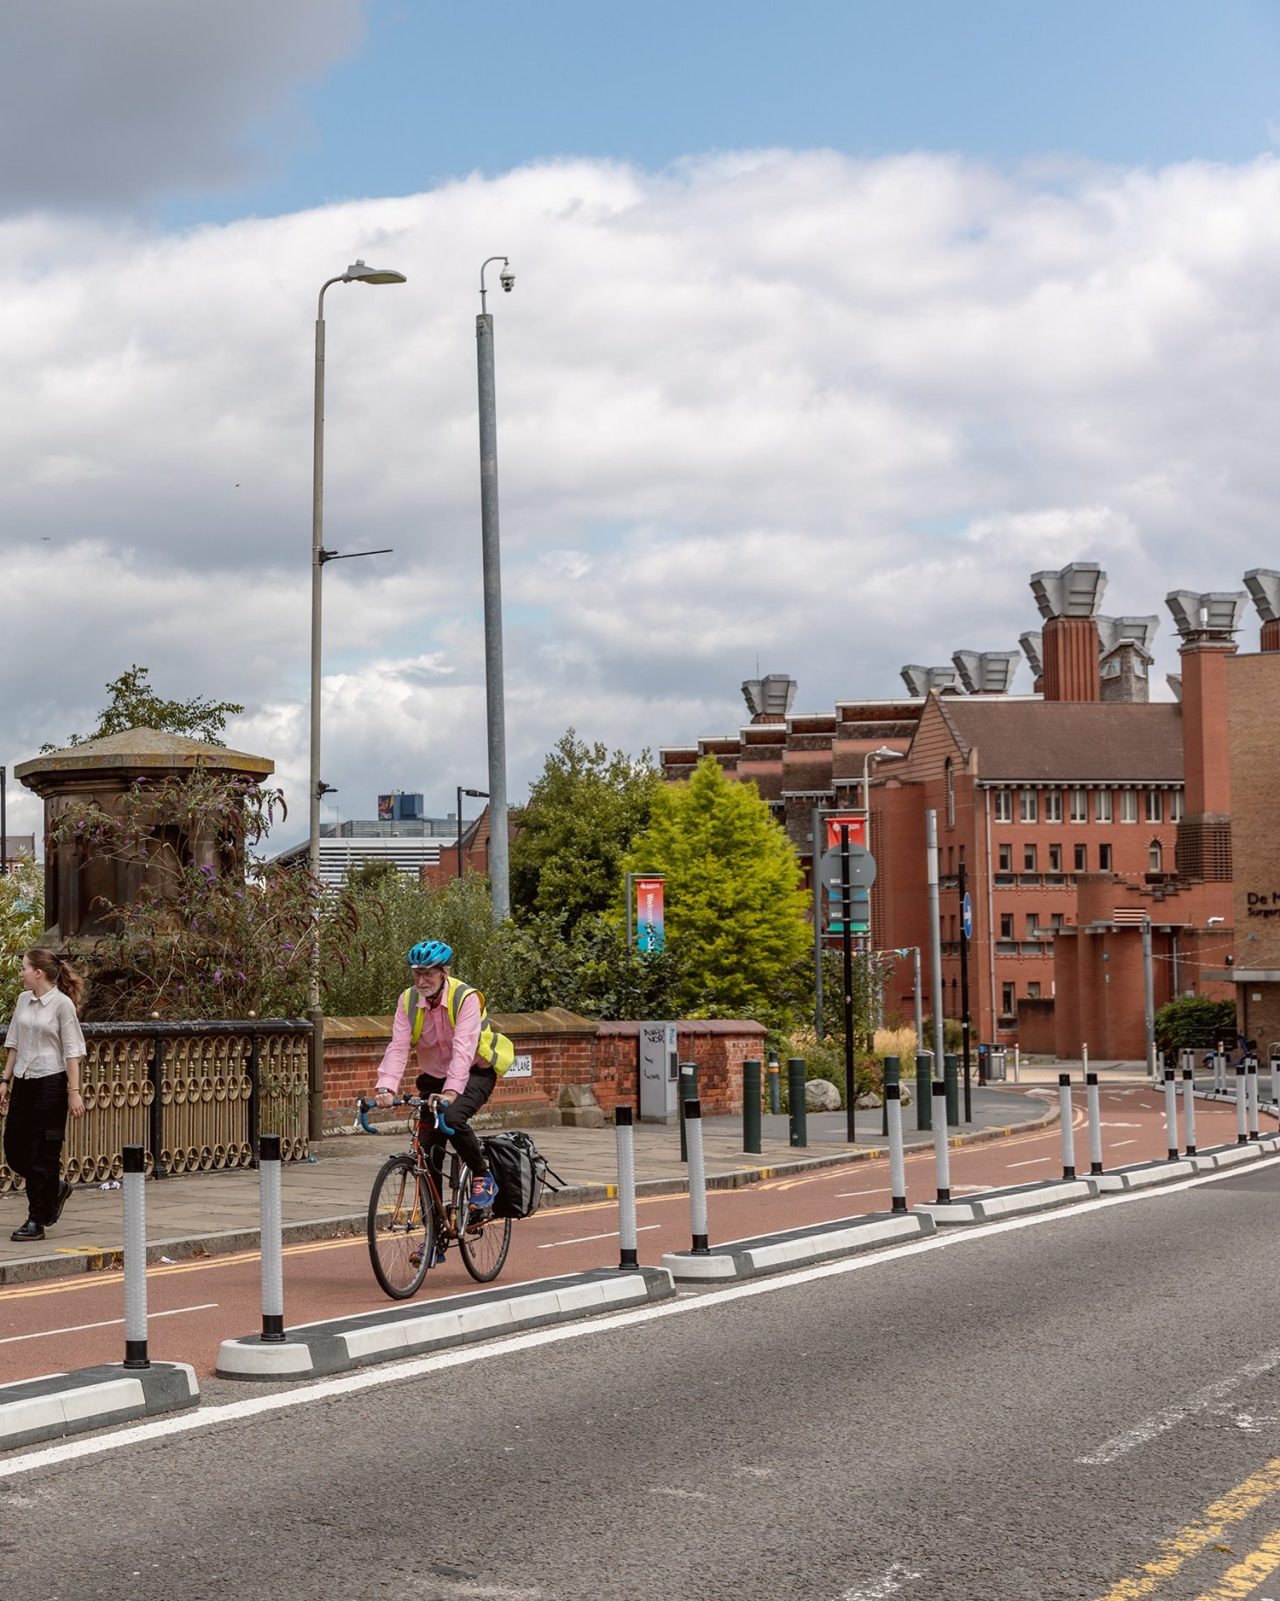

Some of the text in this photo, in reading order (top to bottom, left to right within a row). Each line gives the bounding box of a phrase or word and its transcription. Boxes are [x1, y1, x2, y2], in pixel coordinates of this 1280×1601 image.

[1247, 892, 1268, 905] De
[646, 893, 655, 926] Welcom
[517, 1060, 530, 1072] LANE
